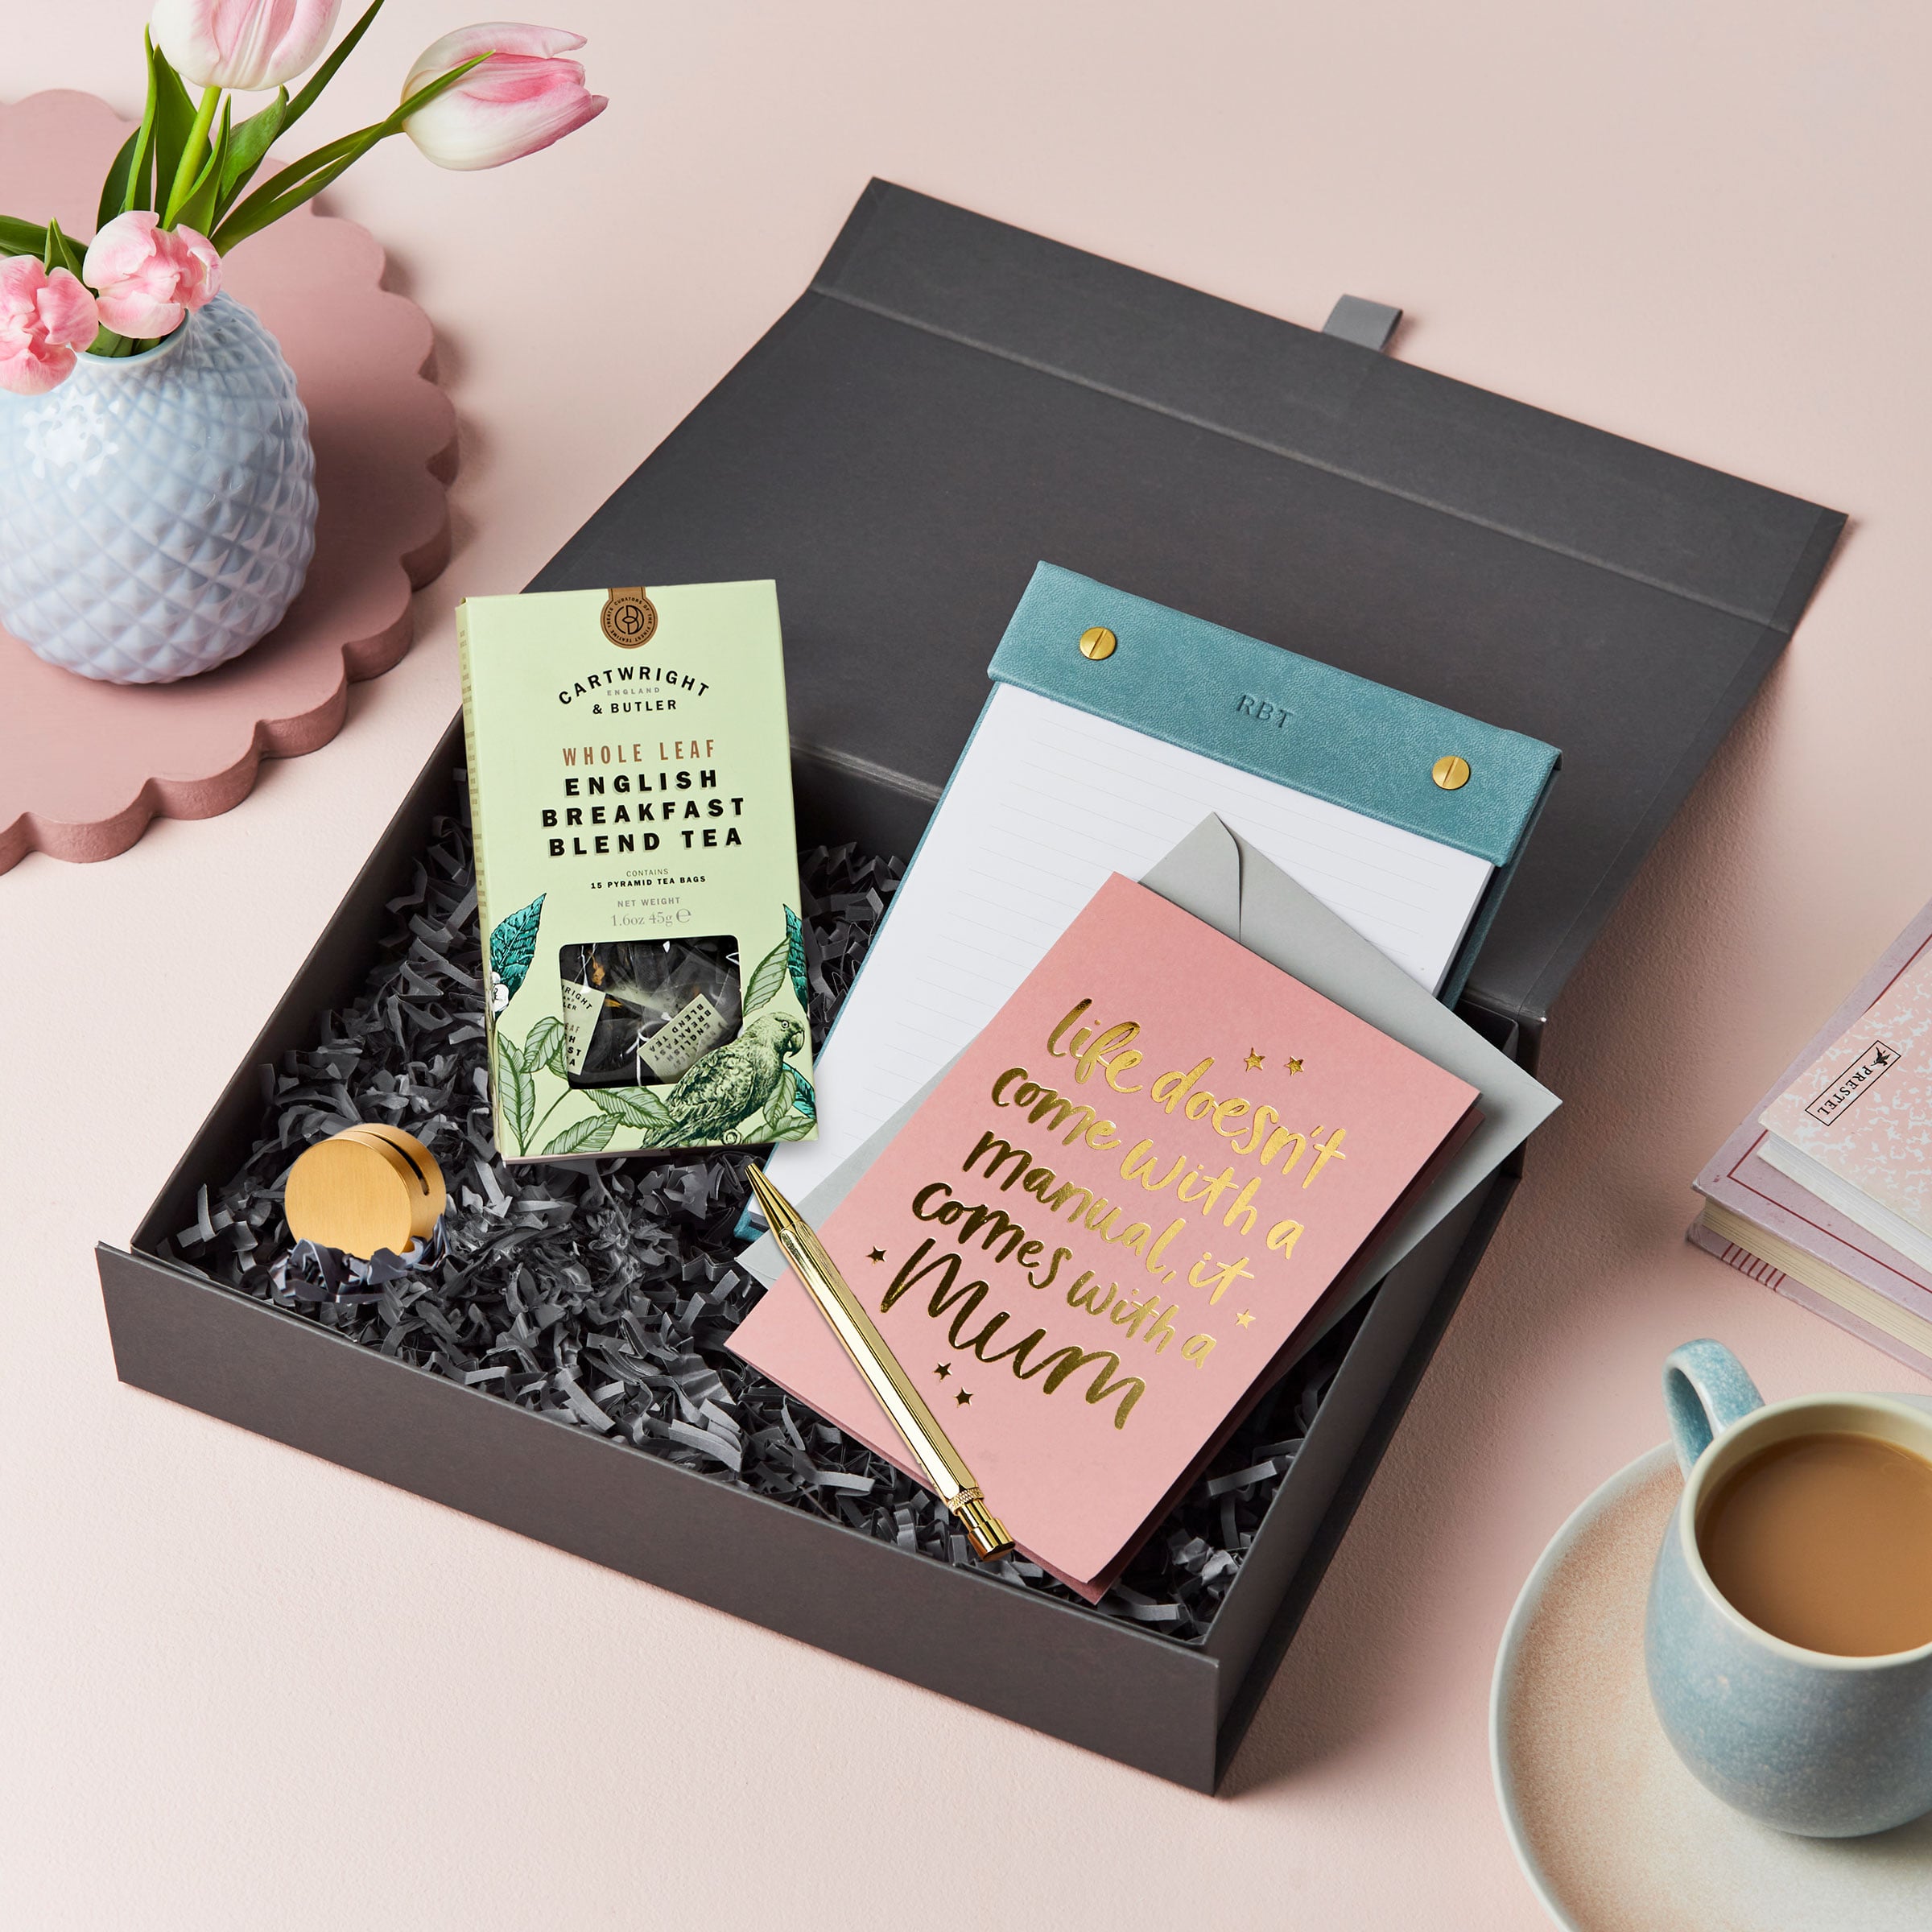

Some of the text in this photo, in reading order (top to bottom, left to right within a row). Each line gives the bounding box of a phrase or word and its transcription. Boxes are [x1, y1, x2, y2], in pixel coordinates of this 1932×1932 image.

[614, 597, 642, 605] CURATORS
[559, 666, 709, 704] CARTWRIGHT
[607, 687, 660, 696] ENGLAND
[592, 700, 677, 714] & BUTLER
[1236, 694, 1294, 728] RBT
[563, 739, 714, 766] WHOLE LEAF
[565, 770, 716, 796] ENGLISH
[542, 797, 744, 828] BREAKFAST
[549, 828, 742, 857] BLEND TEA
[608, 879, 653, 888] PYRAMID
[679, 876, 706, 884] BAGS
[626, 869, 669, 877] CONTAINS
[641, 897, 681, 906] WEIGHT
[611, 913, 645, 927] 1.6oz
[649, 911, 673, 927] 45g
[562, 985, 592, 1009] RIGHT
[672, 1004, 704, 1033] BLEND
[649, 1036, 668, 1052] TEA
[654, 1009, 712, 1061] BREAKFAST
[1046, 997, 1346, 1189] life doesn't
[1817, 1065, 1873, 1115] PRESTEL
[992, 1067, 1122, 1151] come
[1266, 1220, 1304, 1260] a
[912, 1182, 1072, 1289] comes
[1181, 1333, 1216, 1368] a
[1187, 1252, 1254, 1306] it
